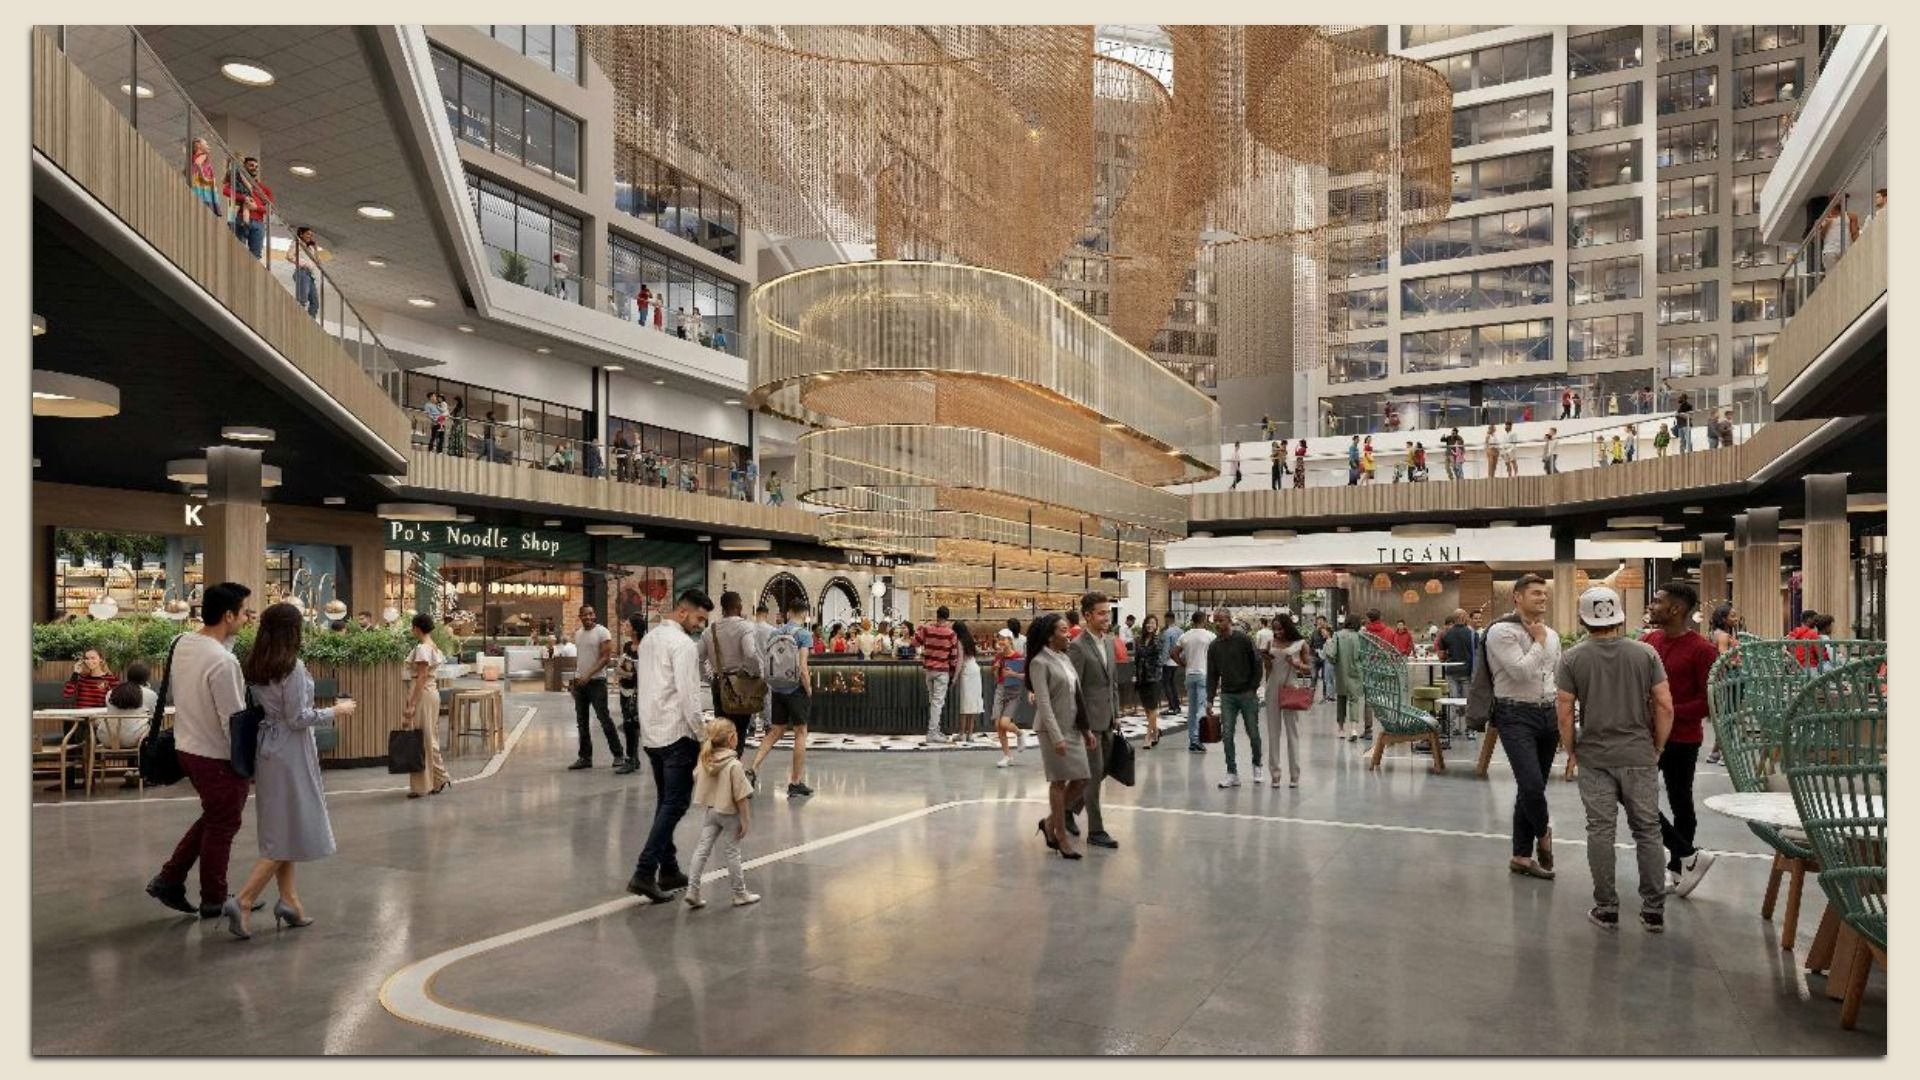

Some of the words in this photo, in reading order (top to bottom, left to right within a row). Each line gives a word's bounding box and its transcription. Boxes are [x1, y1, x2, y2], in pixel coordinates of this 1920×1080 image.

[391, 521, 430, 542] Po's
[447, 526, 508, 548] Noodle
[522, 531, 560, 557] Shop
